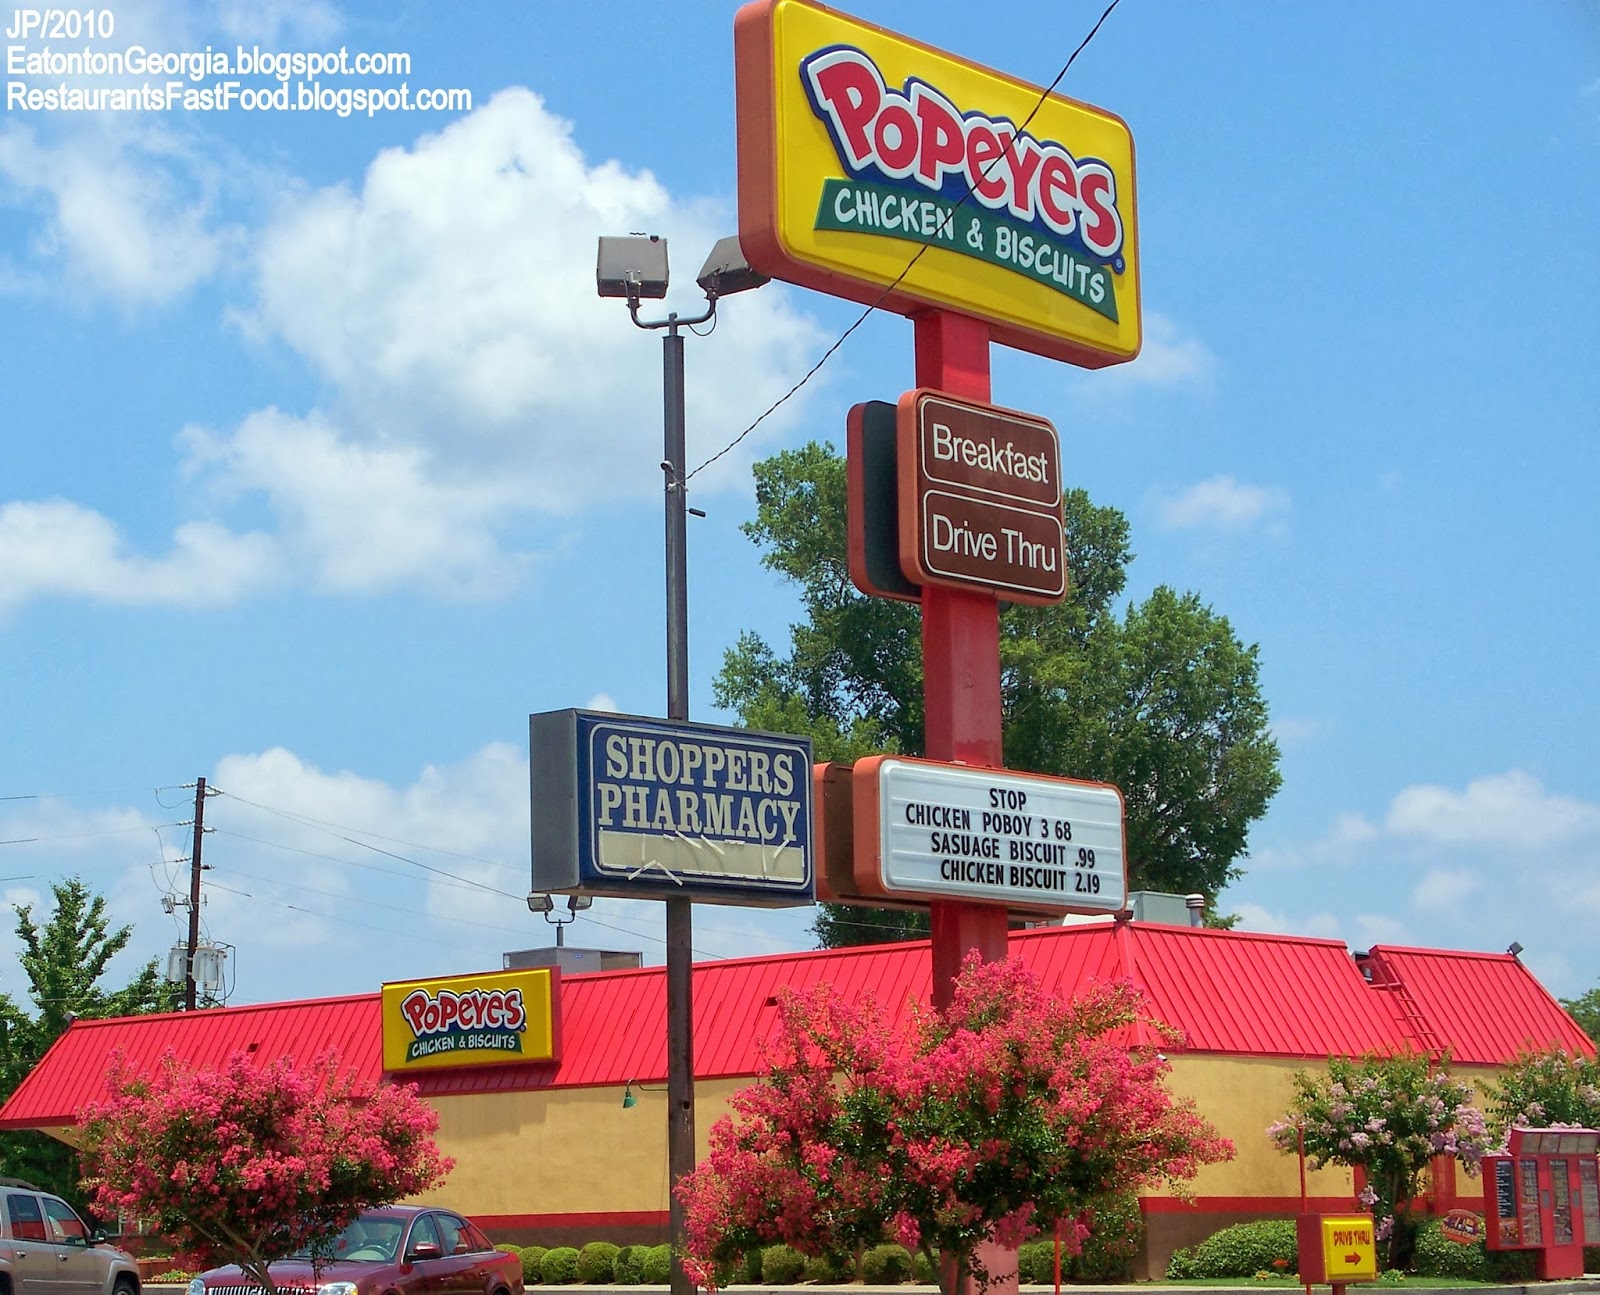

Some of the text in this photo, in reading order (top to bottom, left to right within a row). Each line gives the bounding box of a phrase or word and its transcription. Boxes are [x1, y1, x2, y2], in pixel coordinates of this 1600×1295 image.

[834, 188, 1105, 303] CHICKEN & BISCUITS
[932, 423, 1049, 484] Breakfast
[932, 514, 1056, 573] Drive Thru
[606, 734, 794, 797] SHOPPERS
[597, 783, 801, 842] PHARMACY
[989, 788, 1027, 811] STOP
[905, 803, 971, 830] CHICKEN
[982, 812, 1032, 836] POBOY
[931, 832, 1096, 869] SASUAGE BISCUIT .99
[940, 859, 1101, 894] CHICKEN BISCUIT 2.19
[412, 1034, 516, 1057] CHICKEN & BISCUITS
[1333, 1230, 1370, 1246] DRIVE THRU
